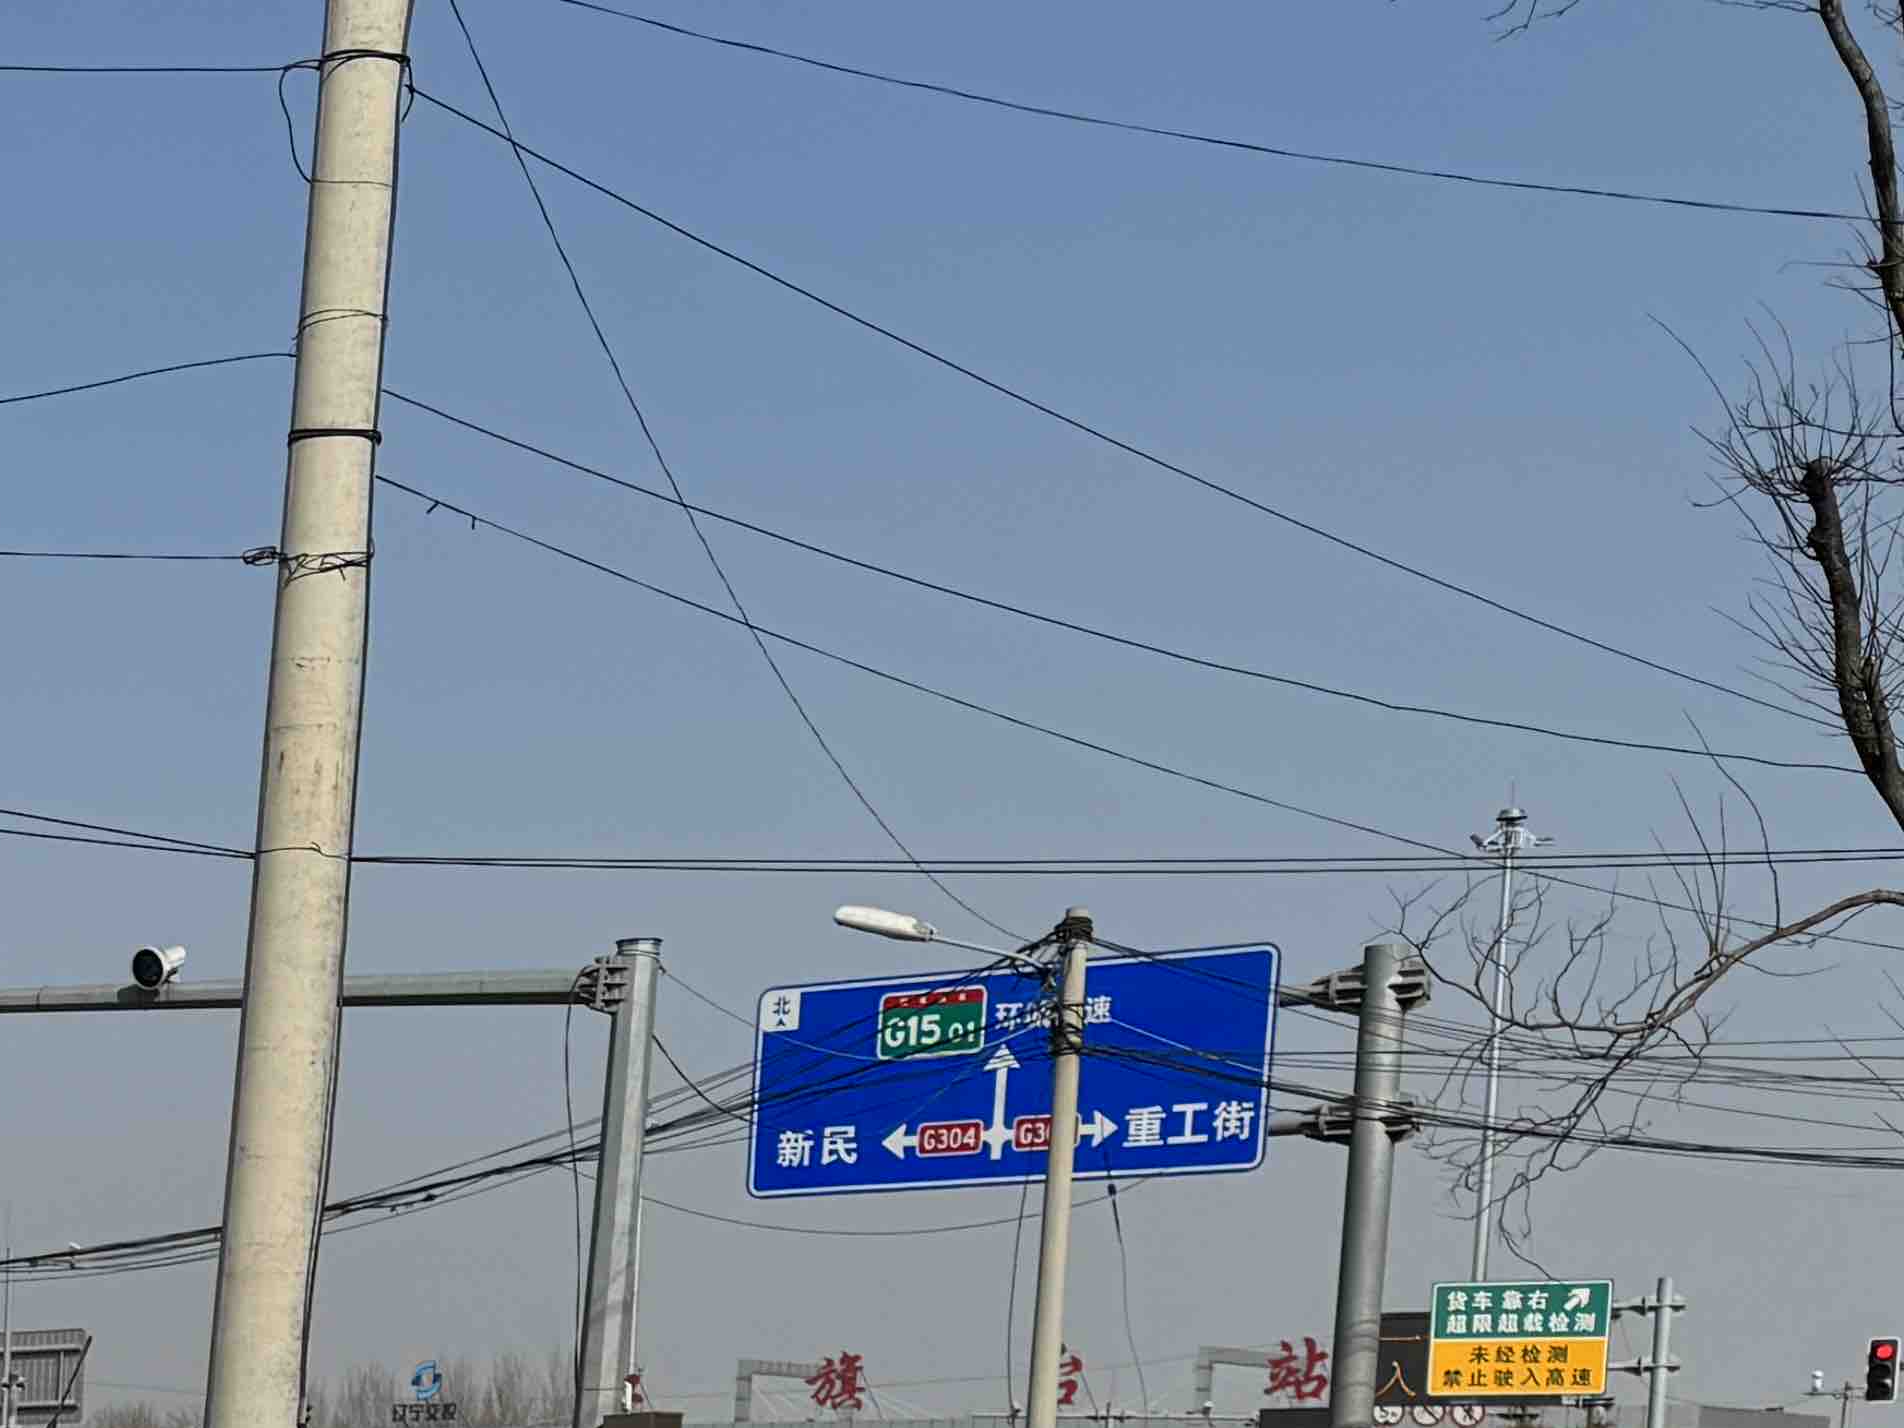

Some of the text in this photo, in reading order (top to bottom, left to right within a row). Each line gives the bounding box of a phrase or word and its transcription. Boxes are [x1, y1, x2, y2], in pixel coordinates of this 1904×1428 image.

[772, 996, 792, 1015] 北
[1121, 1100, 1255, 1148] 重工街
[776, 1125, 859, 1167] 新民
[923, 1128, 977, 1150] G304
[1468, 1344, 1570, 1365] 未经检测
[1442, 1367, 1593, 1388] 禁止驶入高速
